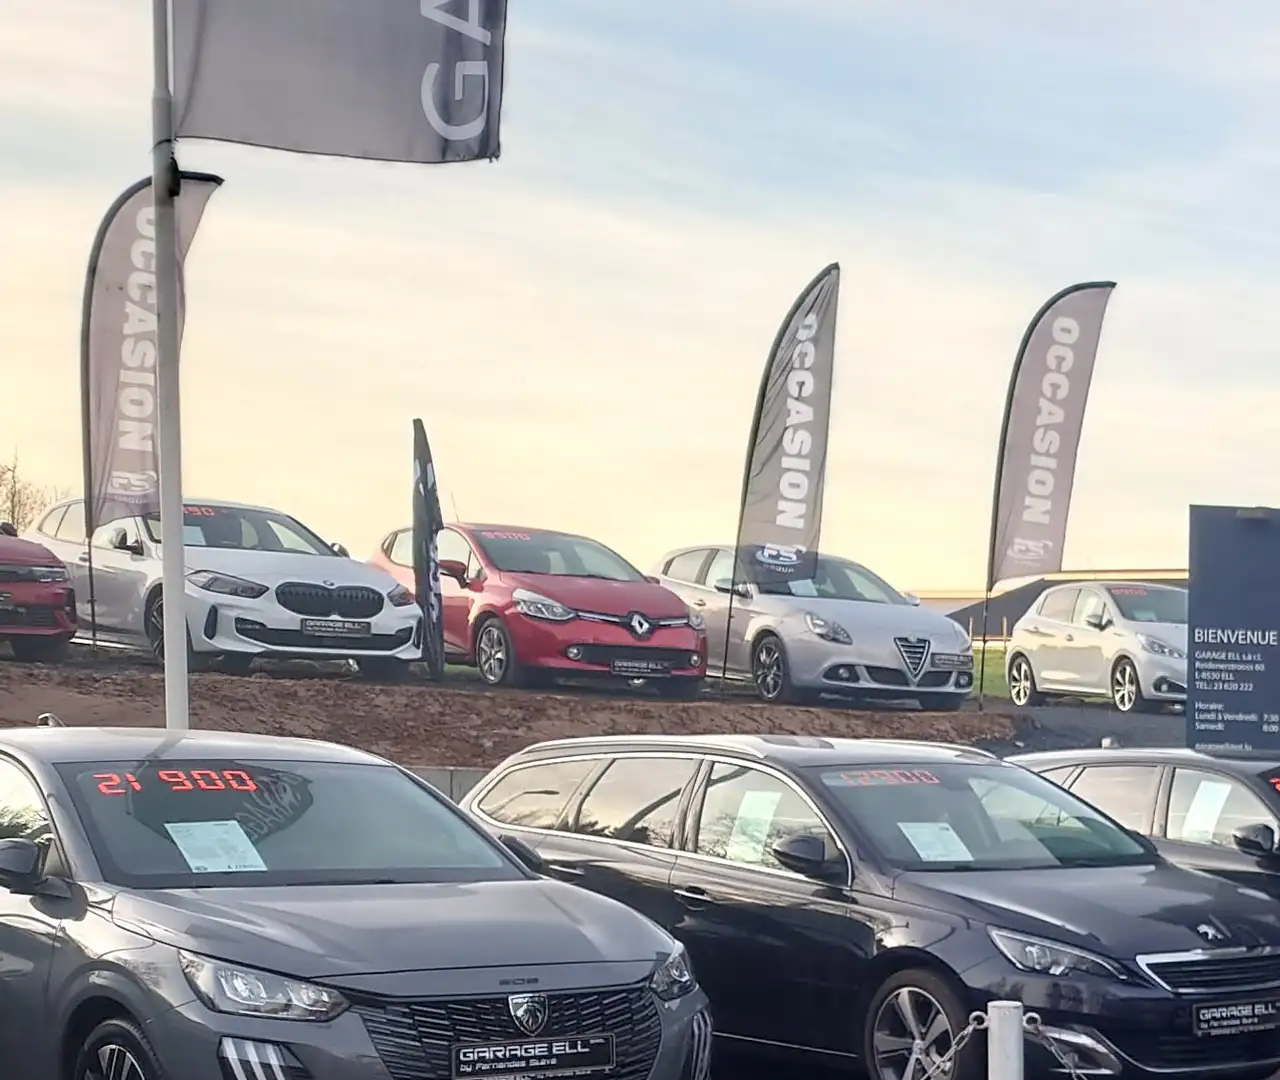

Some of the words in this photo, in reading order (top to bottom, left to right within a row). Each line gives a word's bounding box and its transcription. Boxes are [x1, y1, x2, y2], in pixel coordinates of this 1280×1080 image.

[775, 312, 819, 529] OCCASION
[1022, 316, 1080, 524] OCCASION
[1194, 628, 1278, 645] BIENVENUE
[1195, 650, 1226, 660] GARAGE
[93, 772, 142, 796] 21
[157, 768, 258, 792] 900
[1200, 1004, 1253, 1020] GARAGE
[1254, 1003, 1277, 1015] ELL
[459, 1043, 549, 1062] GARAGE
[552, 1039, 591, 1055] ELL
